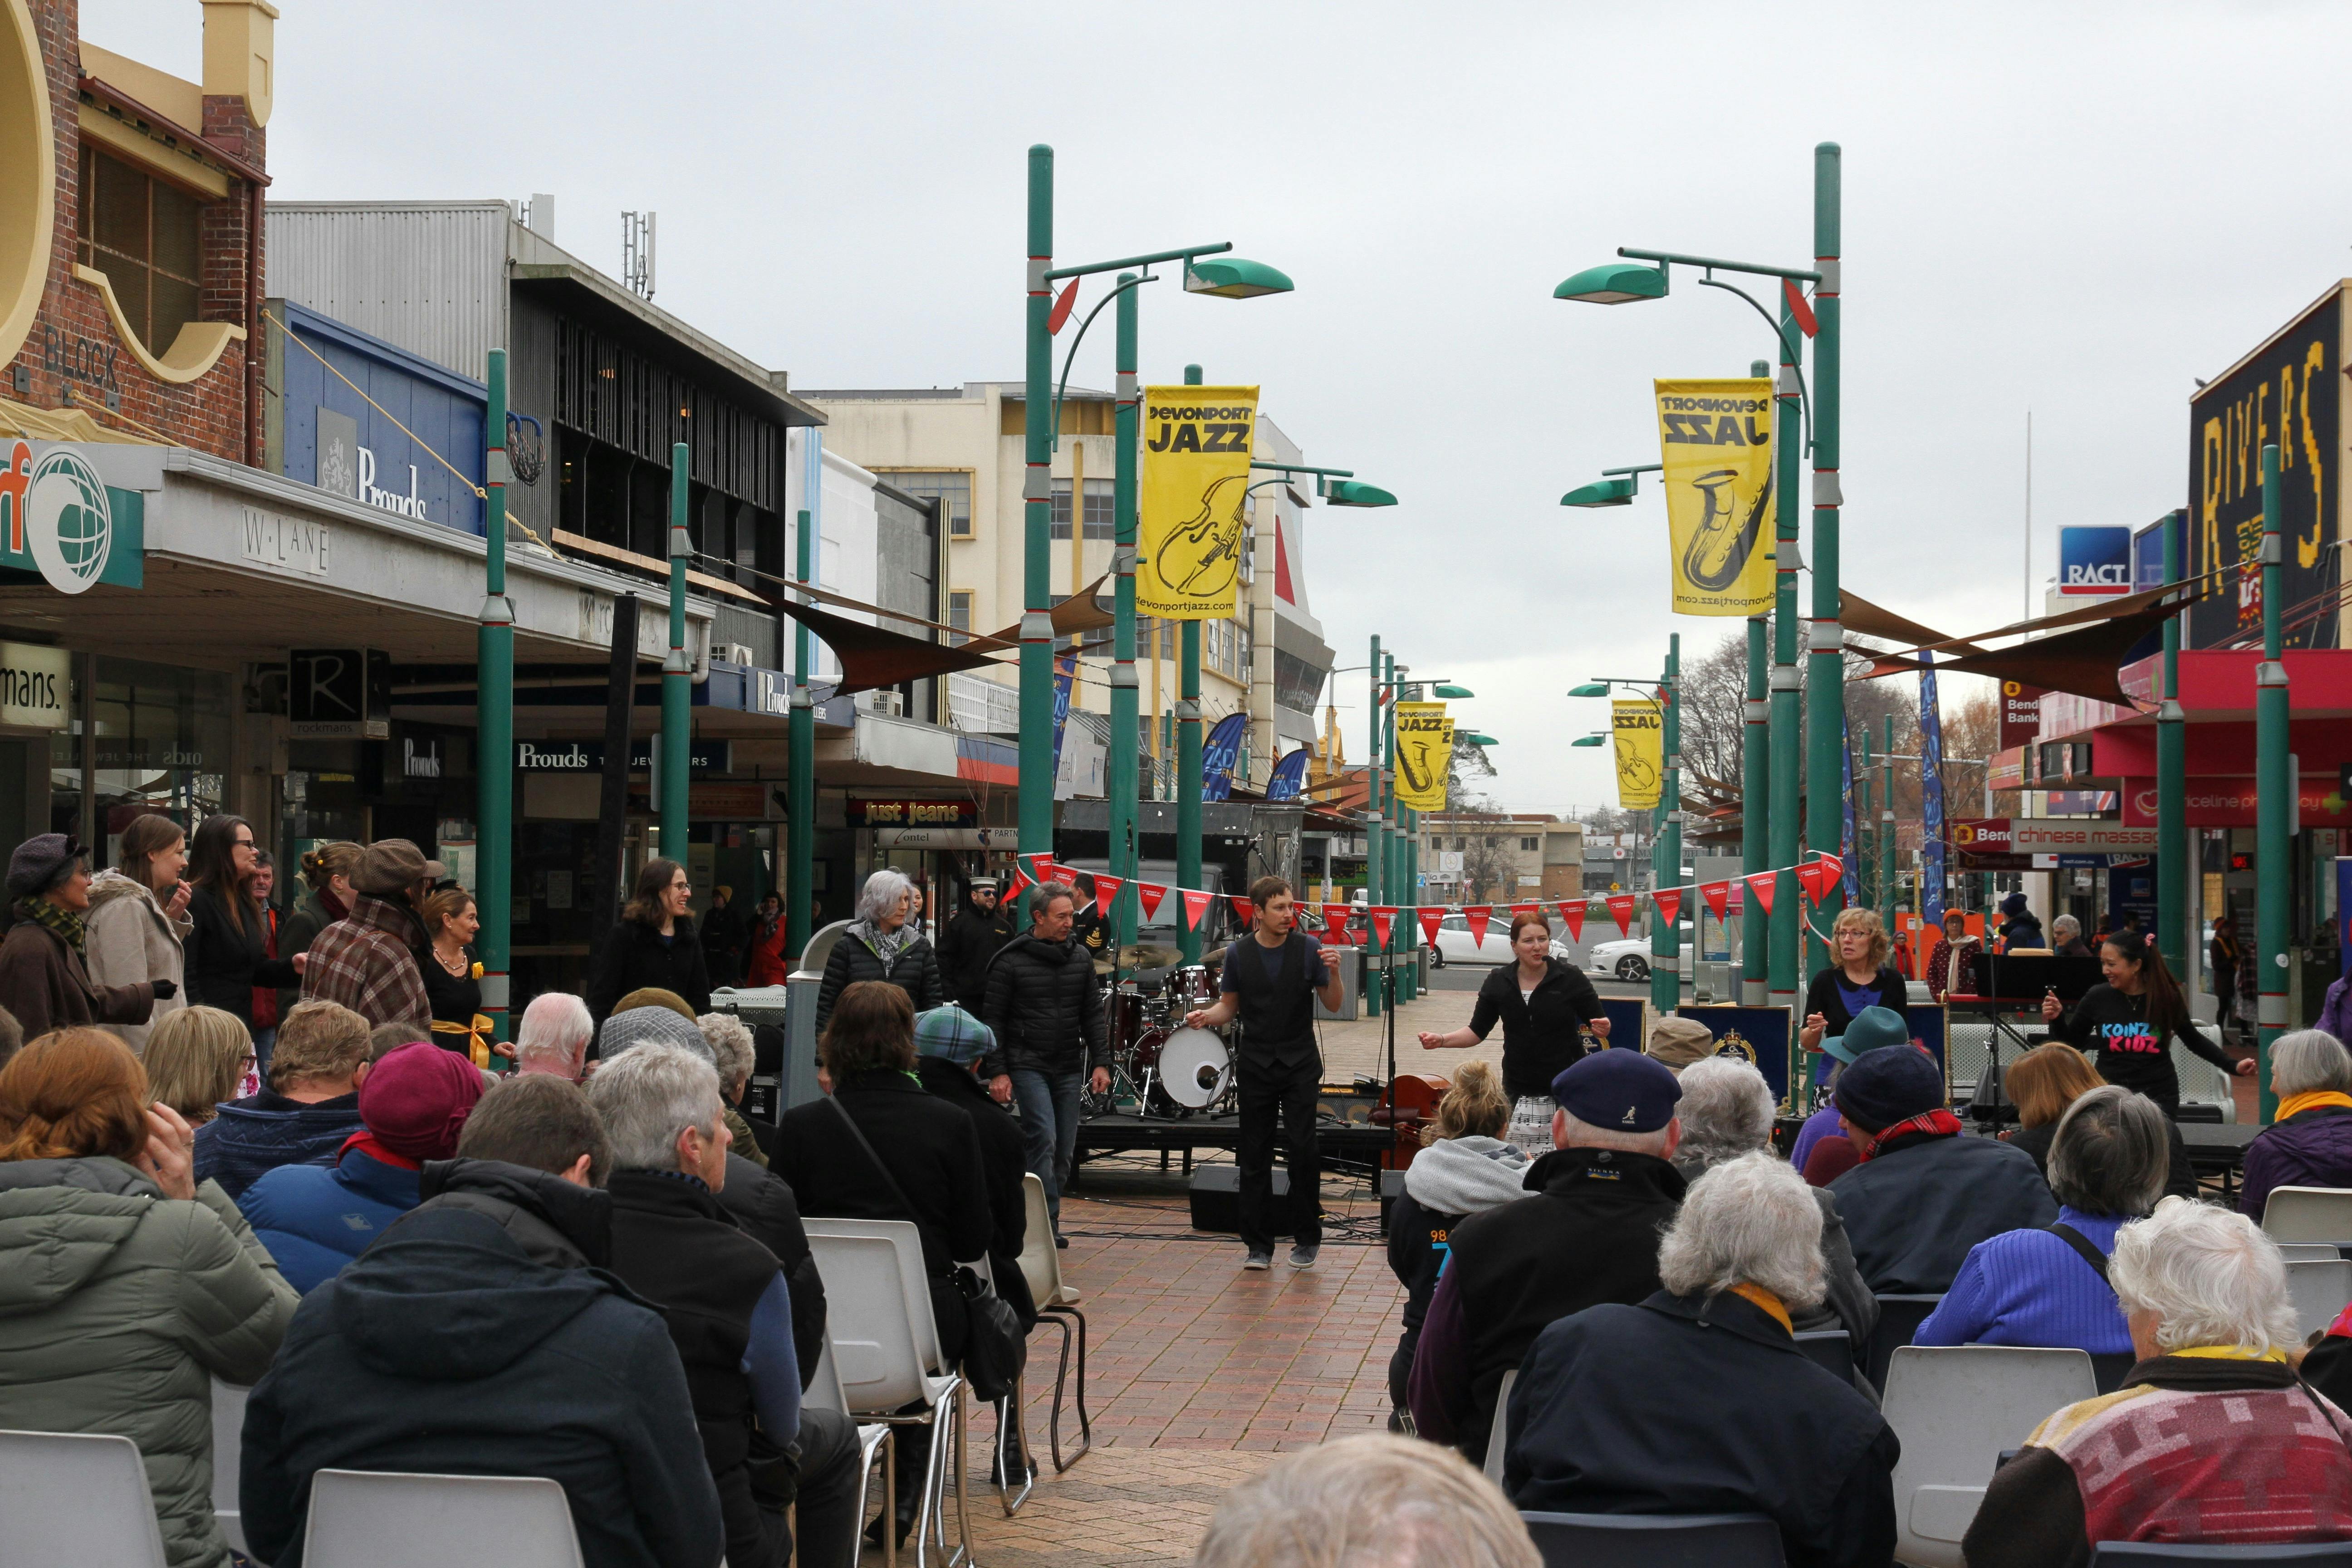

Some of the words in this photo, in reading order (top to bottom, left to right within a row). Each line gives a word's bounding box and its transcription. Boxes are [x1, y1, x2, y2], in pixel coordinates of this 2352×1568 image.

[45, 324, 118, 392] BLOCK
[1148, 423, 1250, 453] JAZZ
[2202, 341, 2323, 601] RIVERS
[2069, 563, 2125, 583] RACT
[297, 656, 356, 716] R
[2008, 700, 2039, 710] Bendi
[298, 722, 352, 733] rockmans
[1399, 719, 1442, 731] JAZZ
[2008, 713, 2039, 723] Bank
[404, 738, 440, 777] Prouds
[519, 744, 588, 767] Prouds
[2019, 826, 2086, 843] chinese
[2109, 1035, 2160, 1053] KIDZ
[1431, 1230, 1447, 1242] 98
